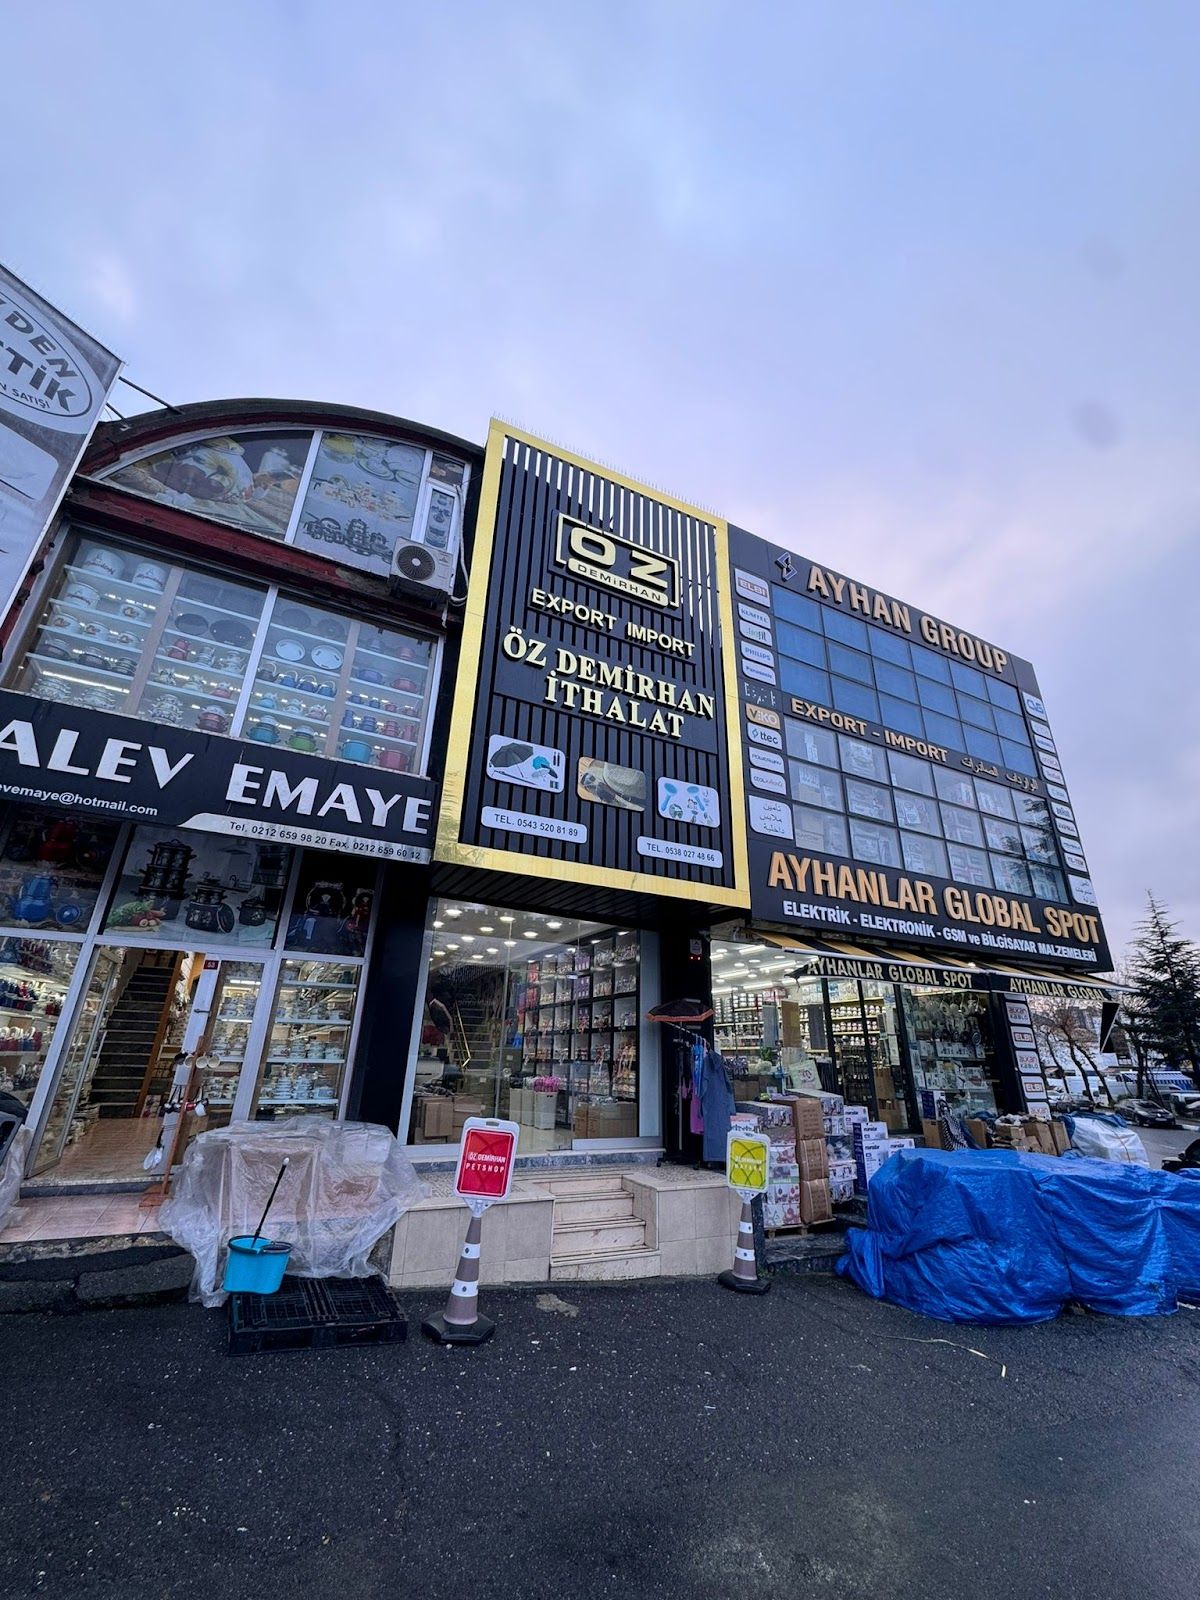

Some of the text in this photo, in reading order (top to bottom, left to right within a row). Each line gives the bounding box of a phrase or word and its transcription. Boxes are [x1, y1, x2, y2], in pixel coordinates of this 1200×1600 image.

[0, 300, 78, 378] DEN
[0, 341, 76, 413] TİK
[12, 388, 51, 409] SATIŞI
[532, 588, 695, 657] EXPORT IMPORT
[808, 565, 1008, 674] AYHAN GROUP
[503, 626, 547, 667] ÖZ
[557, 647, 714, 719] DEMİRHAN
[745, 646, 771, 661] PHILIPS
[745, 665, 773, 679] Panasonic
[545, 670, 684, 738] İTHALAT
[760, 731, 779, 745] ttec
[791, 697, 867, 737] EXPORT
[884, 729, 948, 763] IMPORT
[0, 719, 432, 835] ALEV EMAYE
[0, 783, 158, 817] vemaye@hotmail.com
[230, 821, 421, 860] Tel. 0212 659 98 20 Fax. 0212 659 60 12
[494, 813, 578, 837] TEL. 0543 520 81 89
[647, 842, 664, 853] TEL.
[665, 846, 682, 856] 0538
[683, 848, 696, 858] 027
[768, 851, 938, 916] AYHANLAR
[944, 886, 1041, 934] GLOBAL
[1045, 906, 1100, 944] SPOT
[783, 900, 851, 925] ELEKTRİK
[860, 912, 936, 939] ELEKTRONİK
[943, 927, 967, 943] GSM
[968, 933, 981, 945] ve
[982, 930, 1037, 954] BİLGİSAYAR
[1037, 941, 1098, 963] MALZEMELERİ
[806, 956, 973, 989] AYHANLAR GLOBAL SPOT
[1009, 978, 1108, 1001] AYHANLAR GLOBAL
[465, 1162, 505, 1173] PETSHOP
